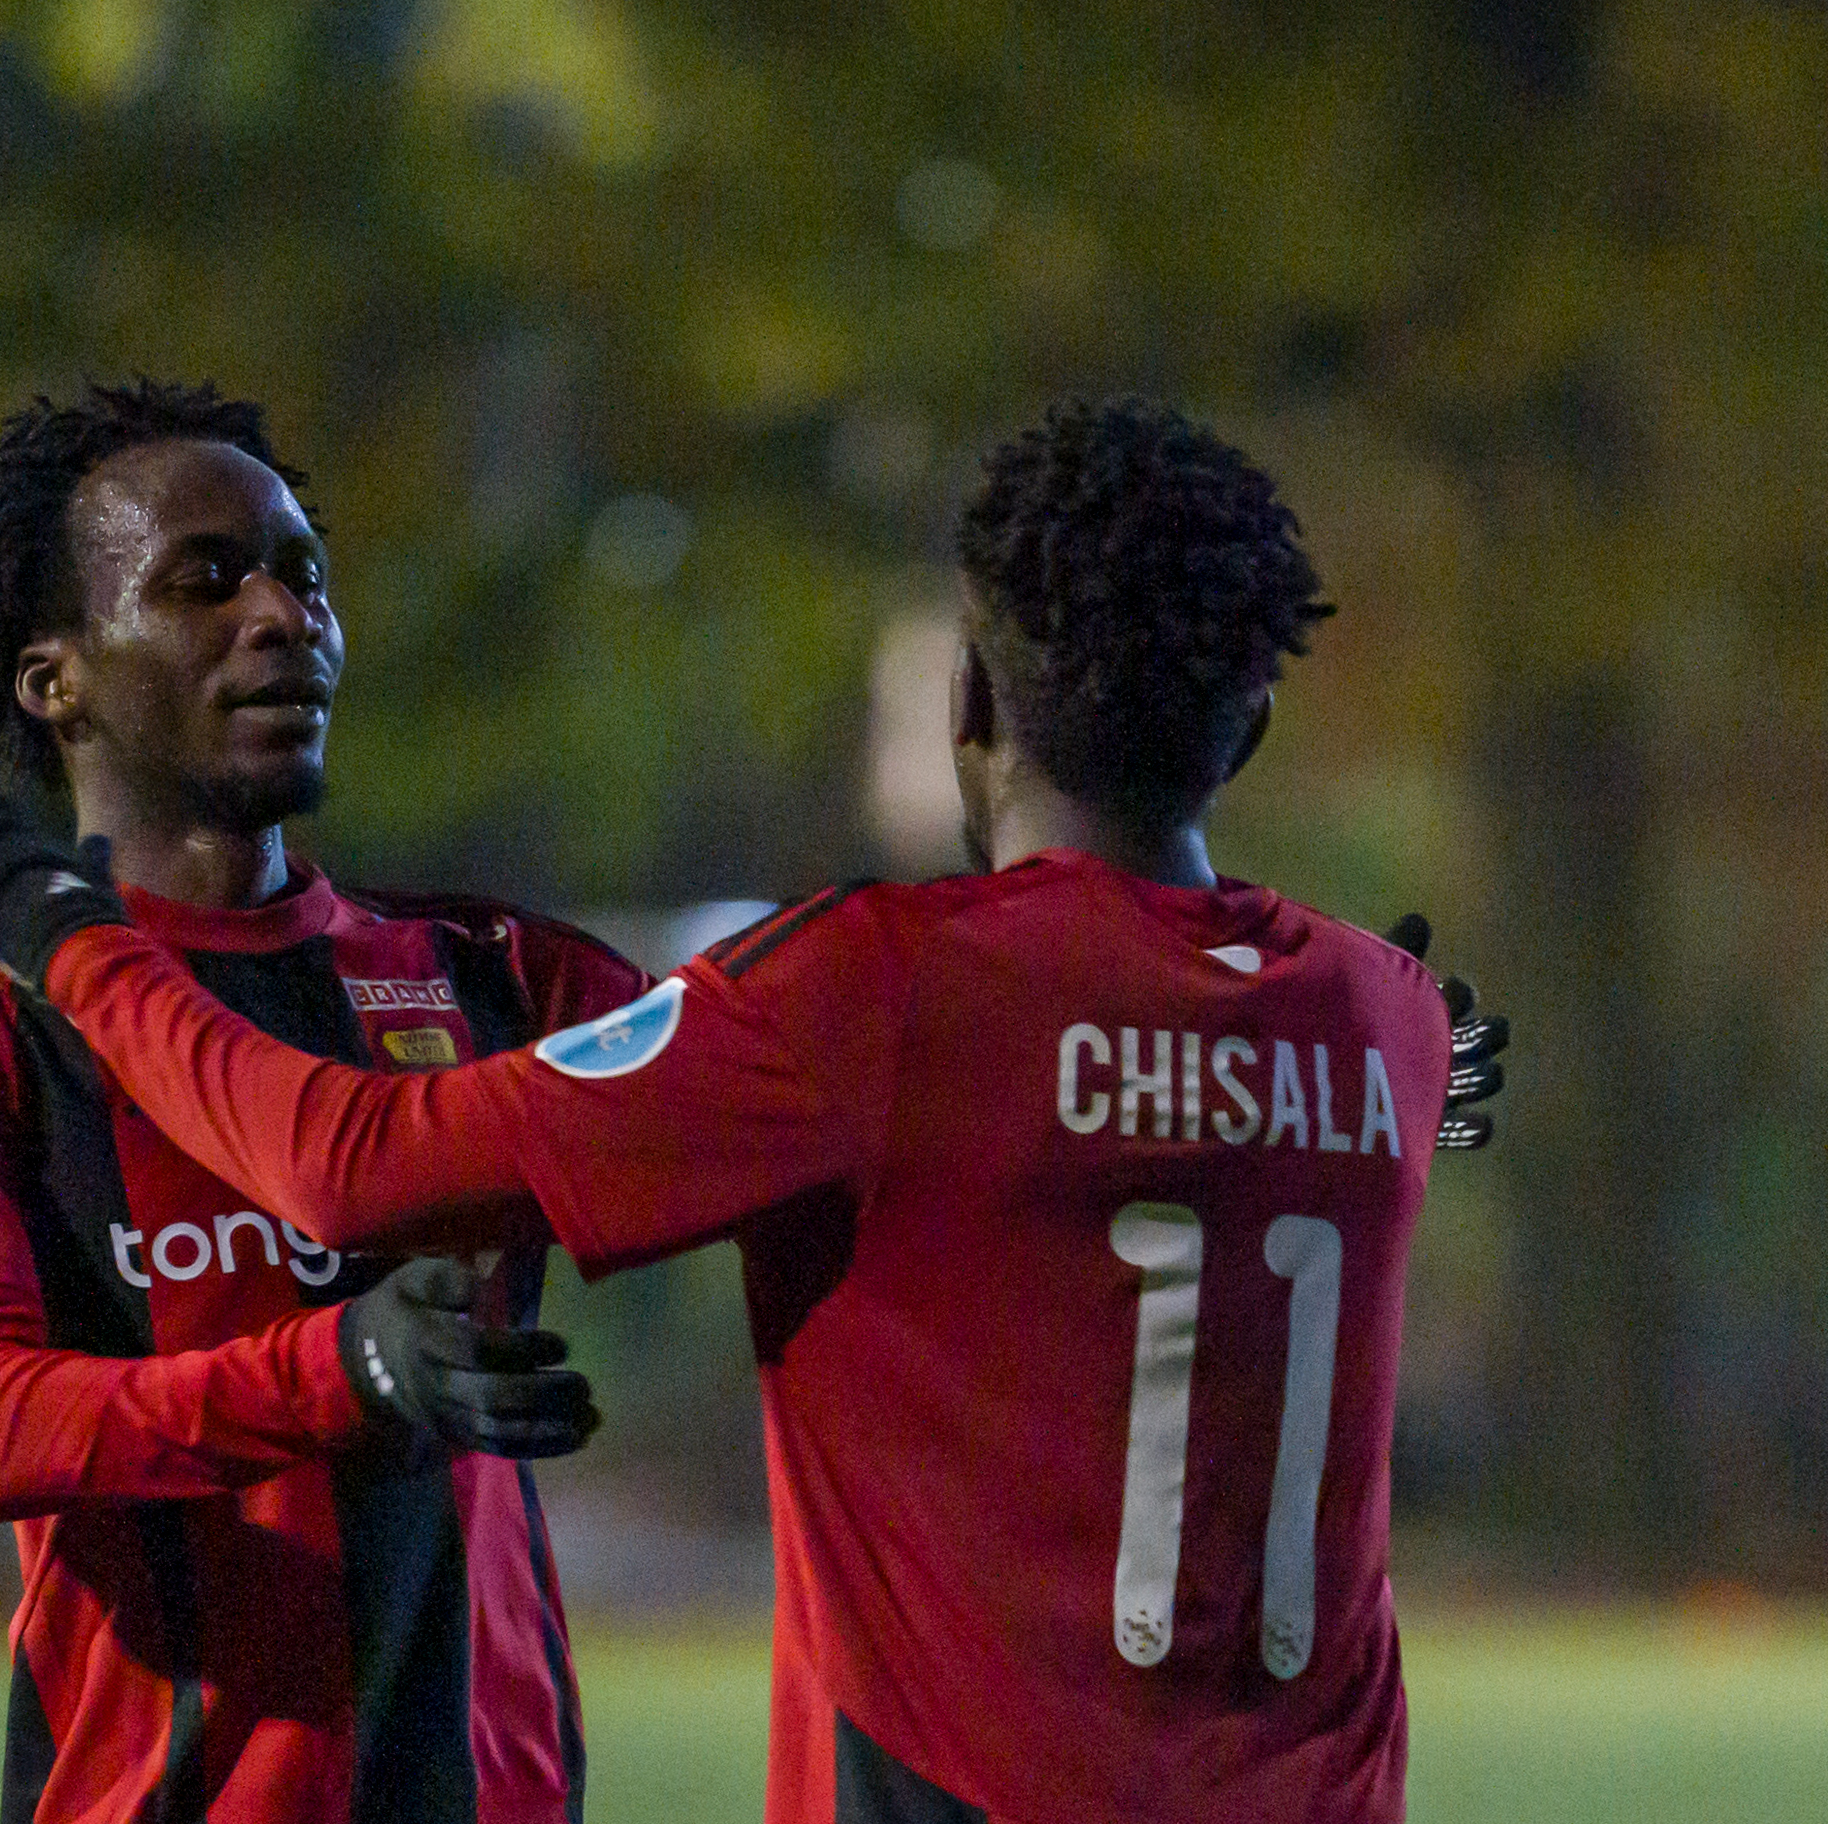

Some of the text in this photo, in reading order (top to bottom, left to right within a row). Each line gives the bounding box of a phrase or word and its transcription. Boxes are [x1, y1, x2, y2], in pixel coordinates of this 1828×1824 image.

[1058, 1021, 1401, 1159] CHISALA
[109, 1210, 361, 1288] tong
[1110, 1201, 1342, 1680] 11
